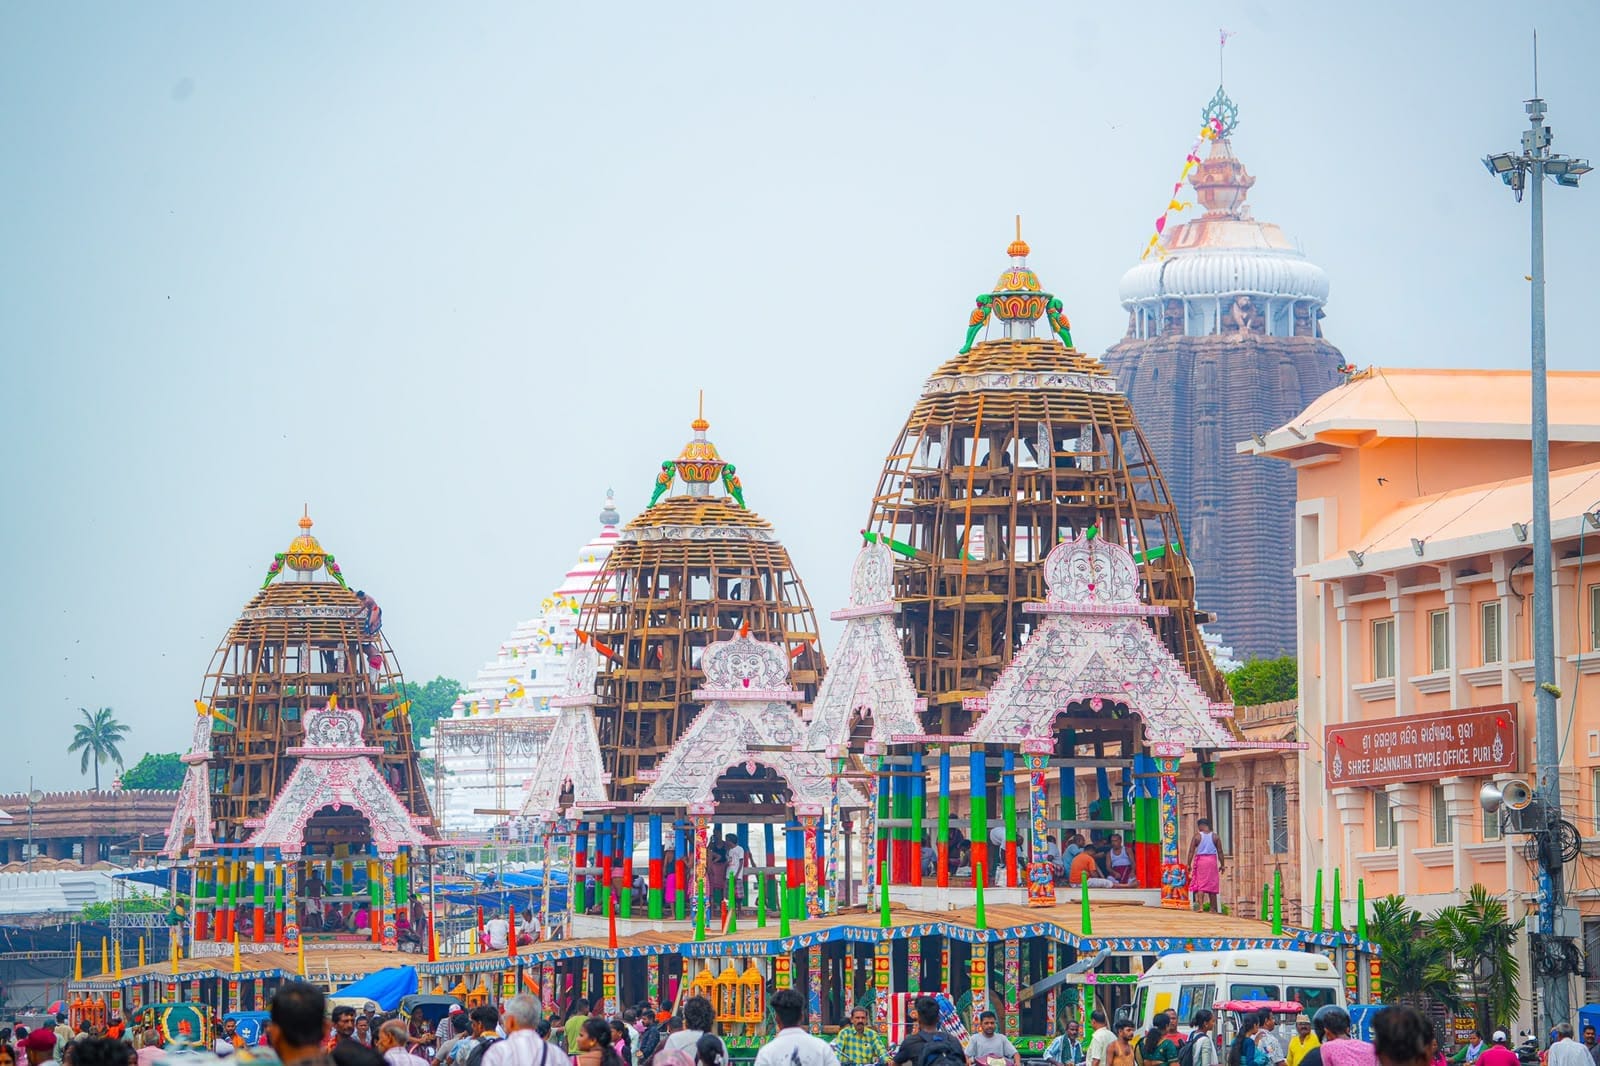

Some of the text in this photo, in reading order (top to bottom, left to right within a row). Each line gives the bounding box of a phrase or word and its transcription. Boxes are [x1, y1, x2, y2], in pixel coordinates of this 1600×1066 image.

[1347, 745, 1491, 775] SHREE JAGANNATHA TEMPLE OFFICE, PURI
